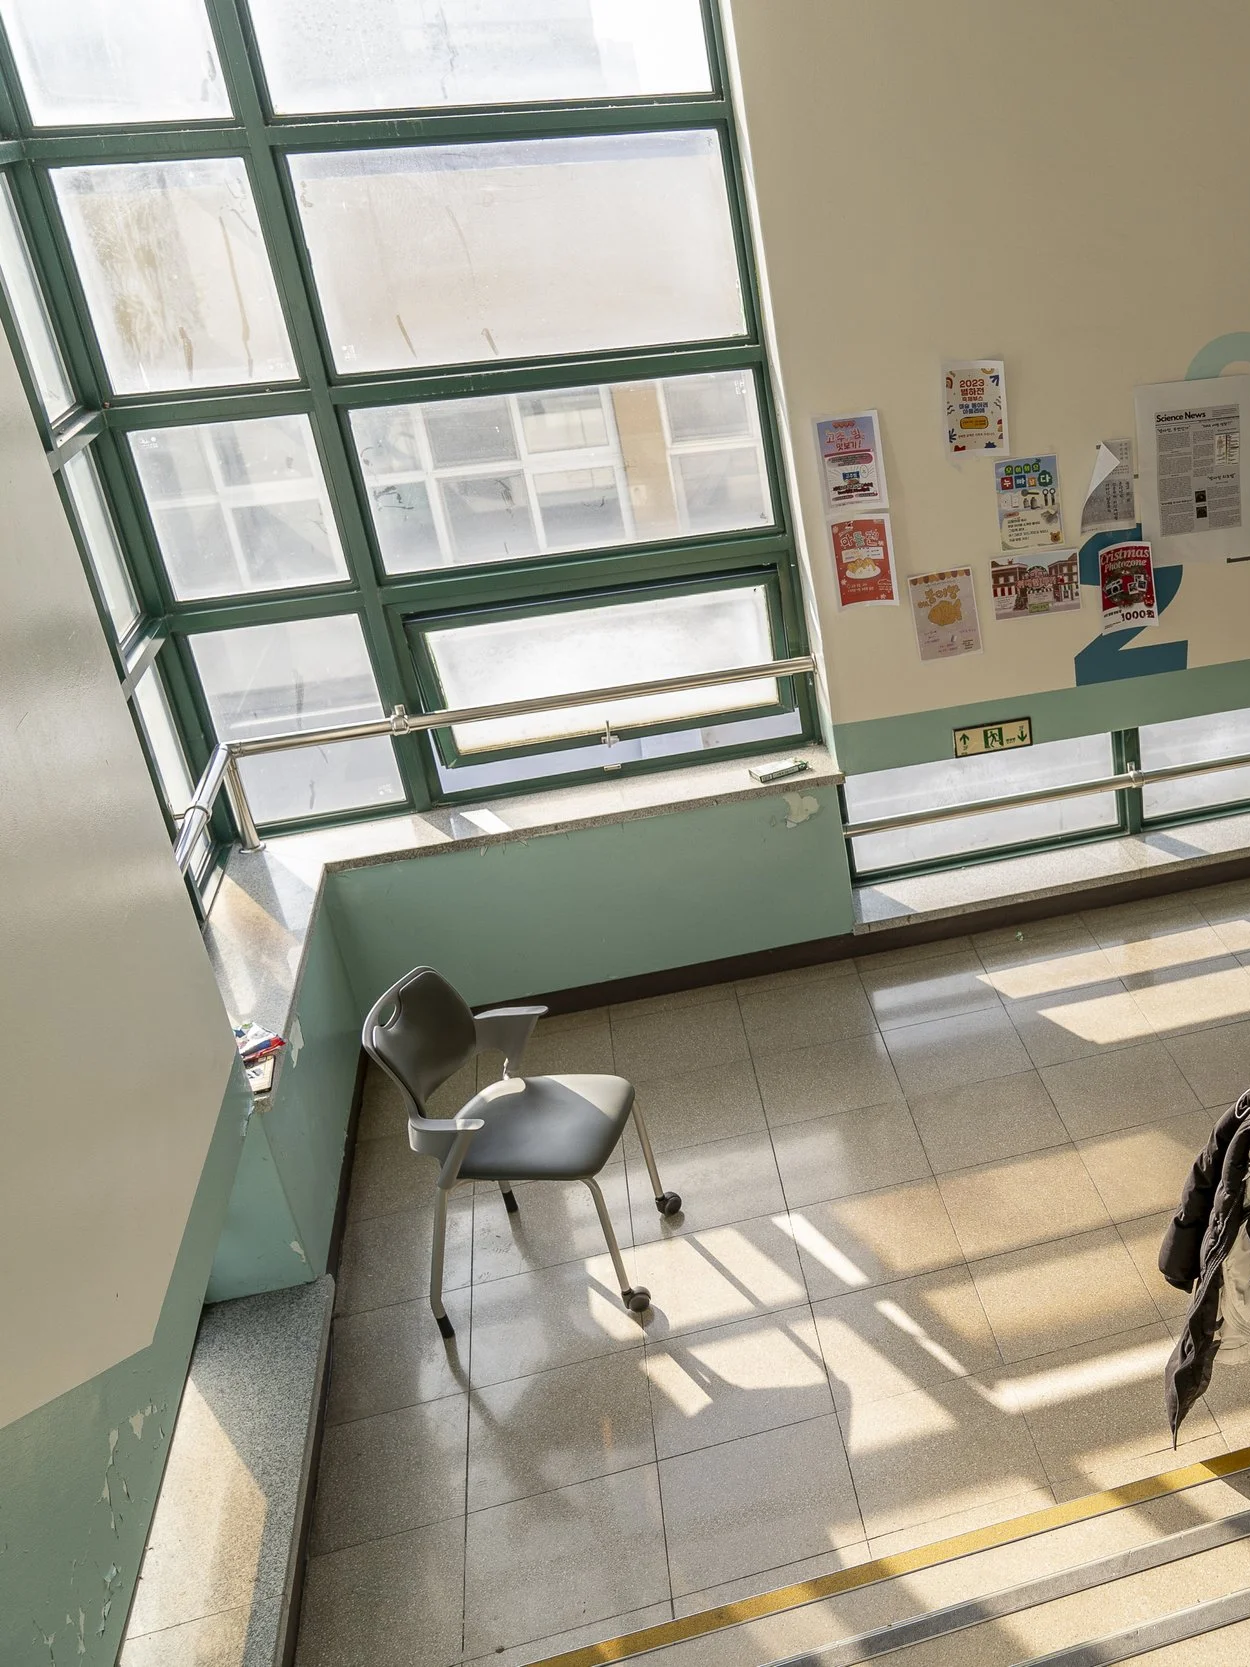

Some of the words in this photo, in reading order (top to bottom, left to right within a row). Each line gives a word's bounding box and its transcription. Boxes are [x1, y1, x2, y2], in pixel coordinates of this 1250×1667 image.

[959, 379, 985, 389] 2023
[1156, 413, 1184, 423] Science
[1184, 410, 1206, 419] News
[1101, 548, 1150, 566] Cristmas
[1104, 559, 1147, 573] Photozone
